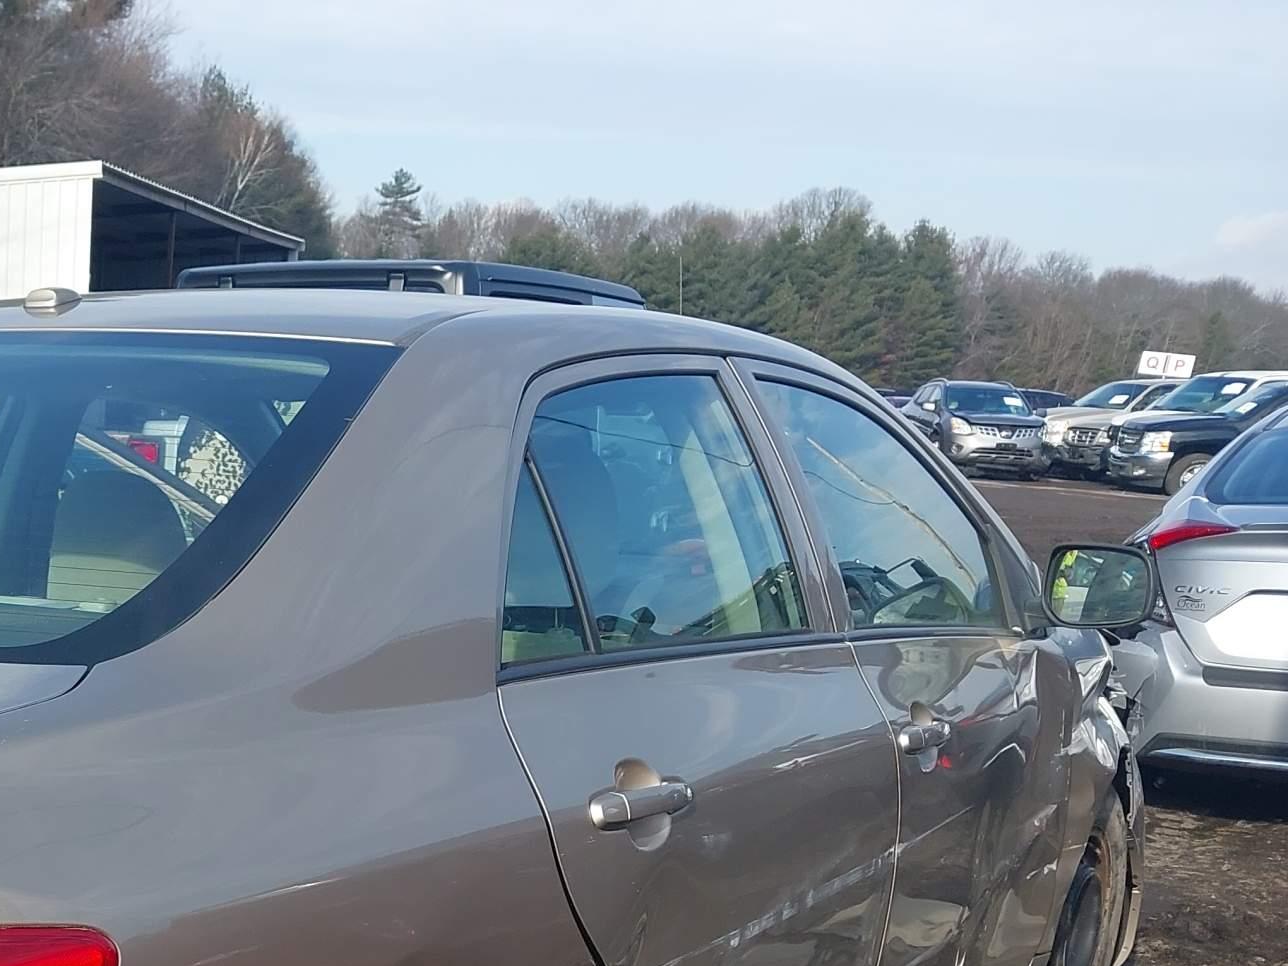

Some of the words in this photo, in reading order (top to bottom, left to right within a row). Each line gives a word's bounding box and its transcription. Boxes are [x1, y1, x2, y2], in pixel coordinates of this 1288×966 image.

[1146, 356, 1159, 370] Q
[1174, 359, 1186, 371] P
[1174, 584, 1232, 595] CIVIC
[1176, 598, 1206, 609] Ocean
